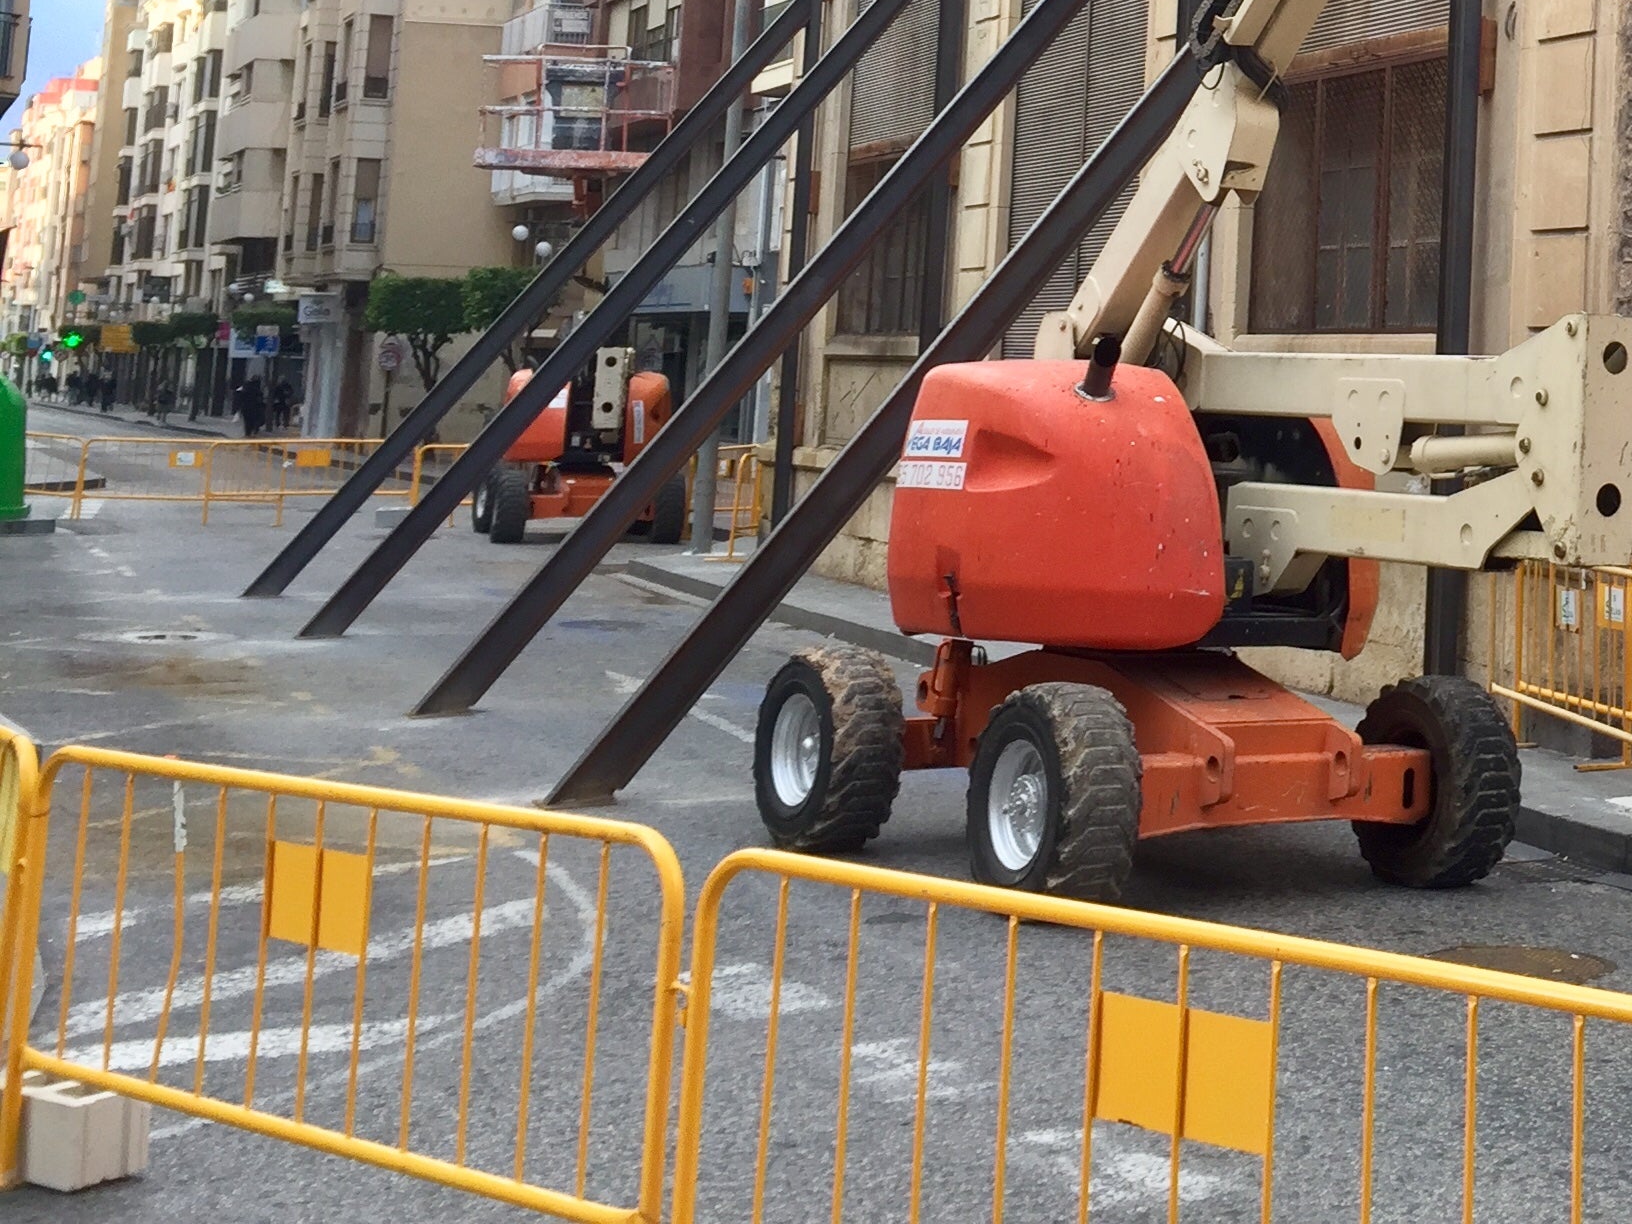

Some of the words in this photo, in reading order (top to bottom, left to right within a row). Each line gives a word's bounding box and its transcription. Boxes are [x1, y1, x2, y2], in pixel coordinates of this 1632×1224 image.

[933, 436, 962, 454] BAJA
[910, 464, 933, 485] 702
[935, 465, 963, 487] 956
